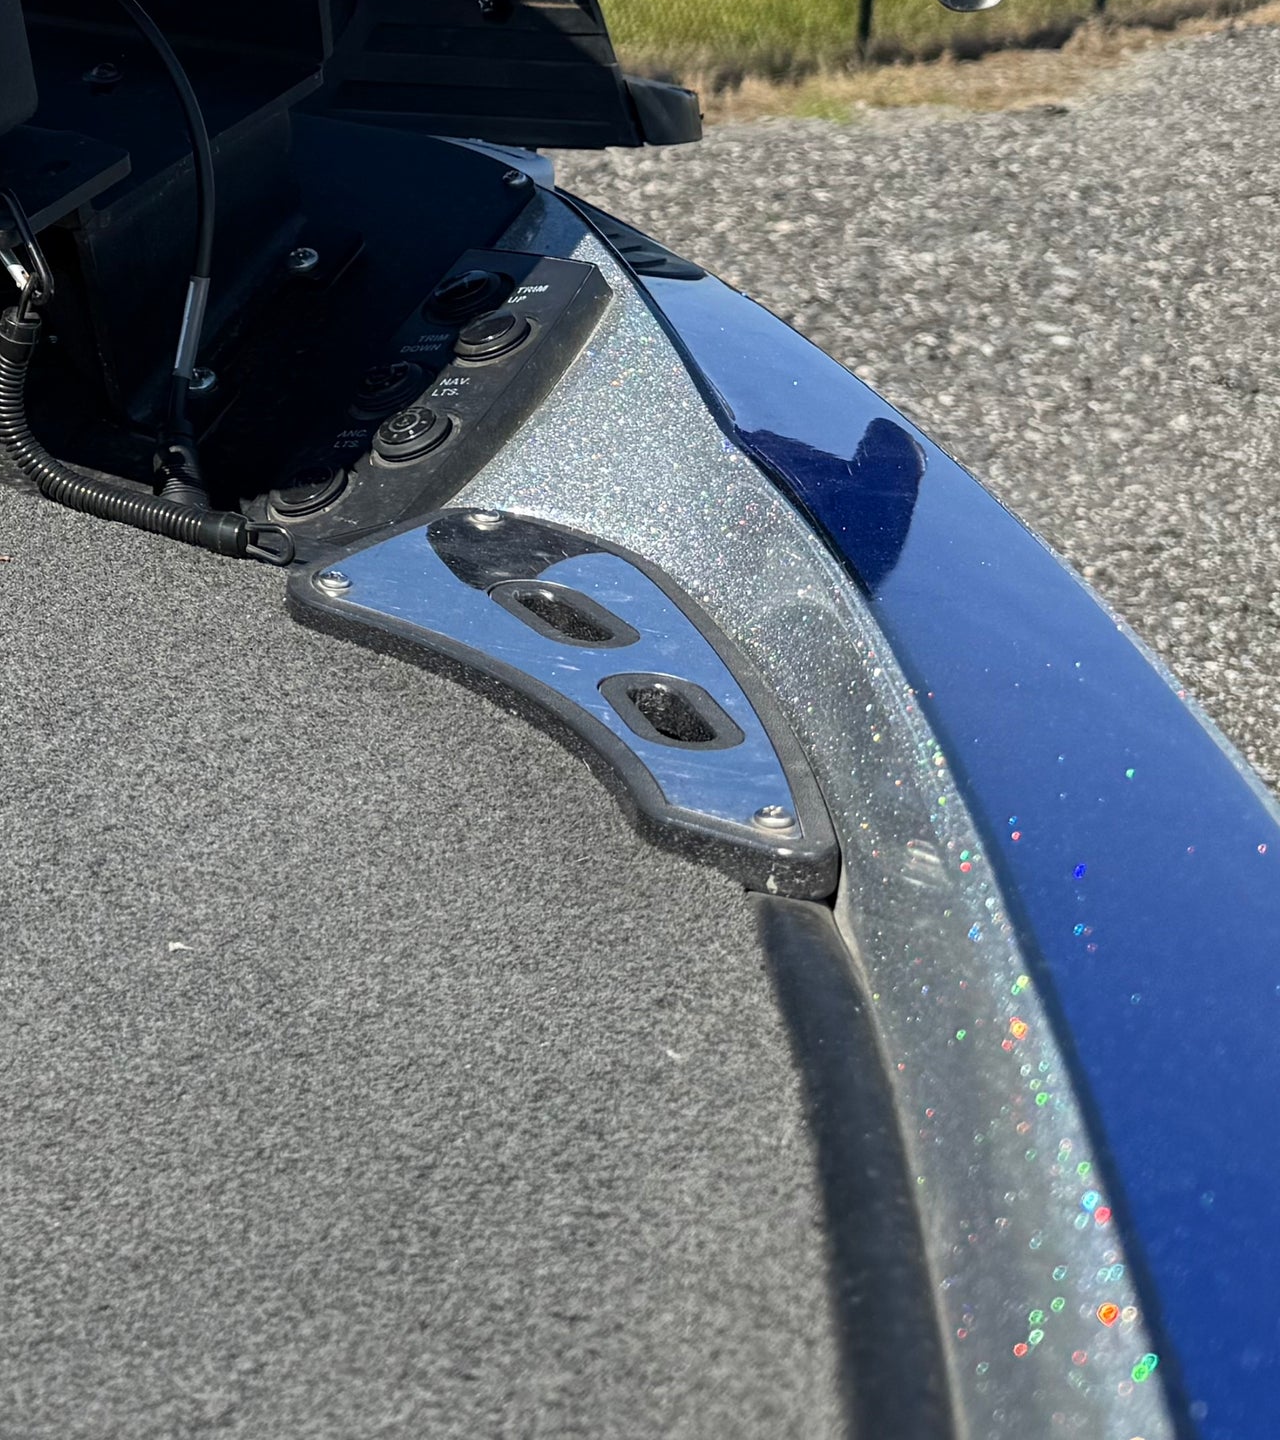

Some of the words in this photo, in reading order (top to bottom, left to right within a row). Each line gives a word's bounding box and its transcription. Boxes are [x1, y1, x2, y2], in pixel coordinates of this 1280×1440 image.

[516, 284, 550, 294] TRIM
[507, 295, 527, 304] UP
[417, 333, 450, 344] TRIM
[439, 377, 471, 386] NAV.
[431, 388, 460, 397] LTS.
